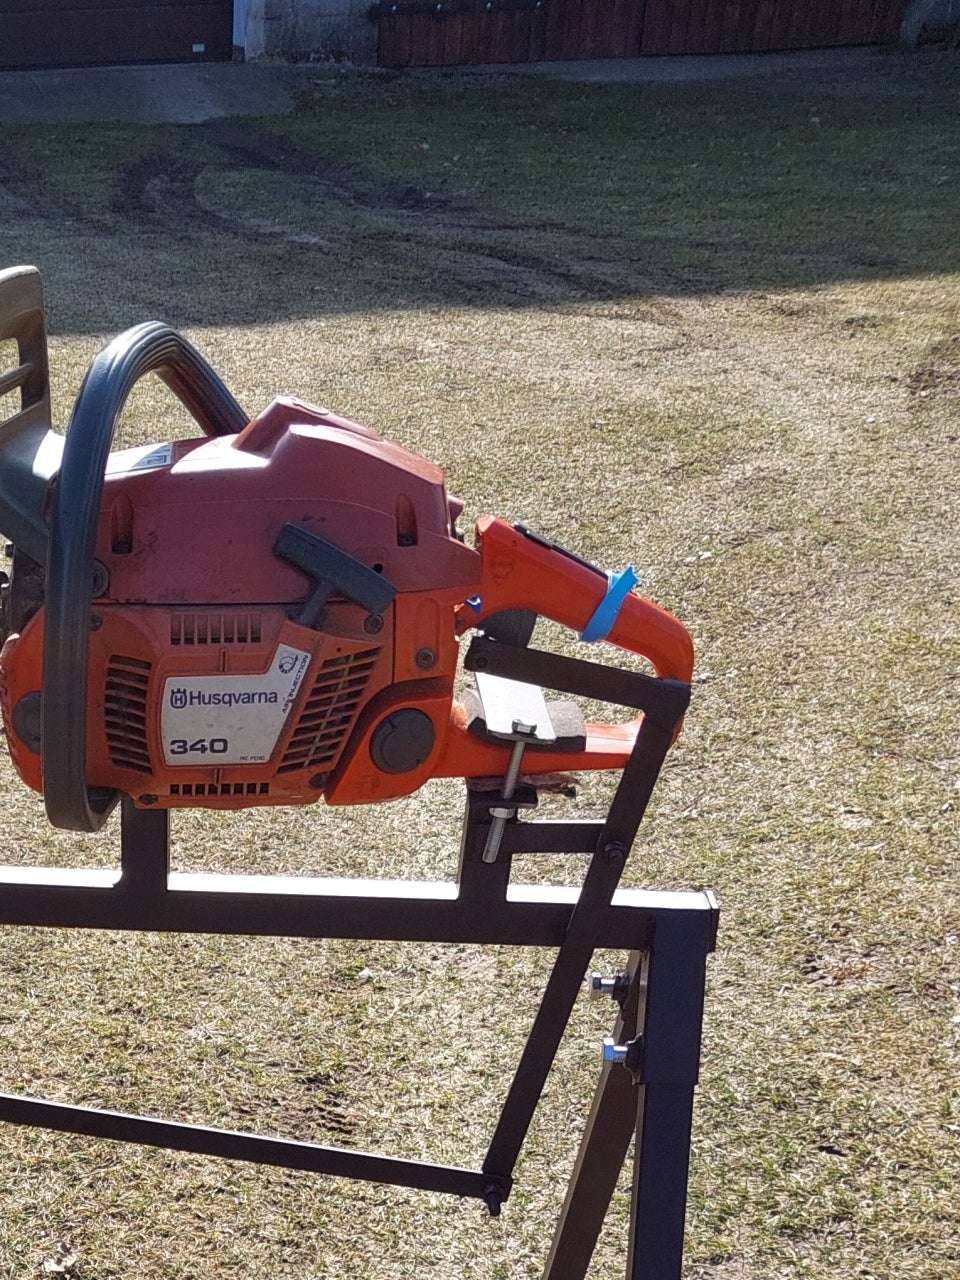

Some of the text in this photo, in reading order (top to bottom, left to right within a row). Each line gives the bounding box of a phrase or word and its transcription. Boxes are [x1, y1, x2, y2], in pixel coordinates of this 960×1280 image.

[287, 654, 309, 698] INJECTION
[189, 690, 278, 708] Husqvarna
[170, 738, 228, 755] 340
